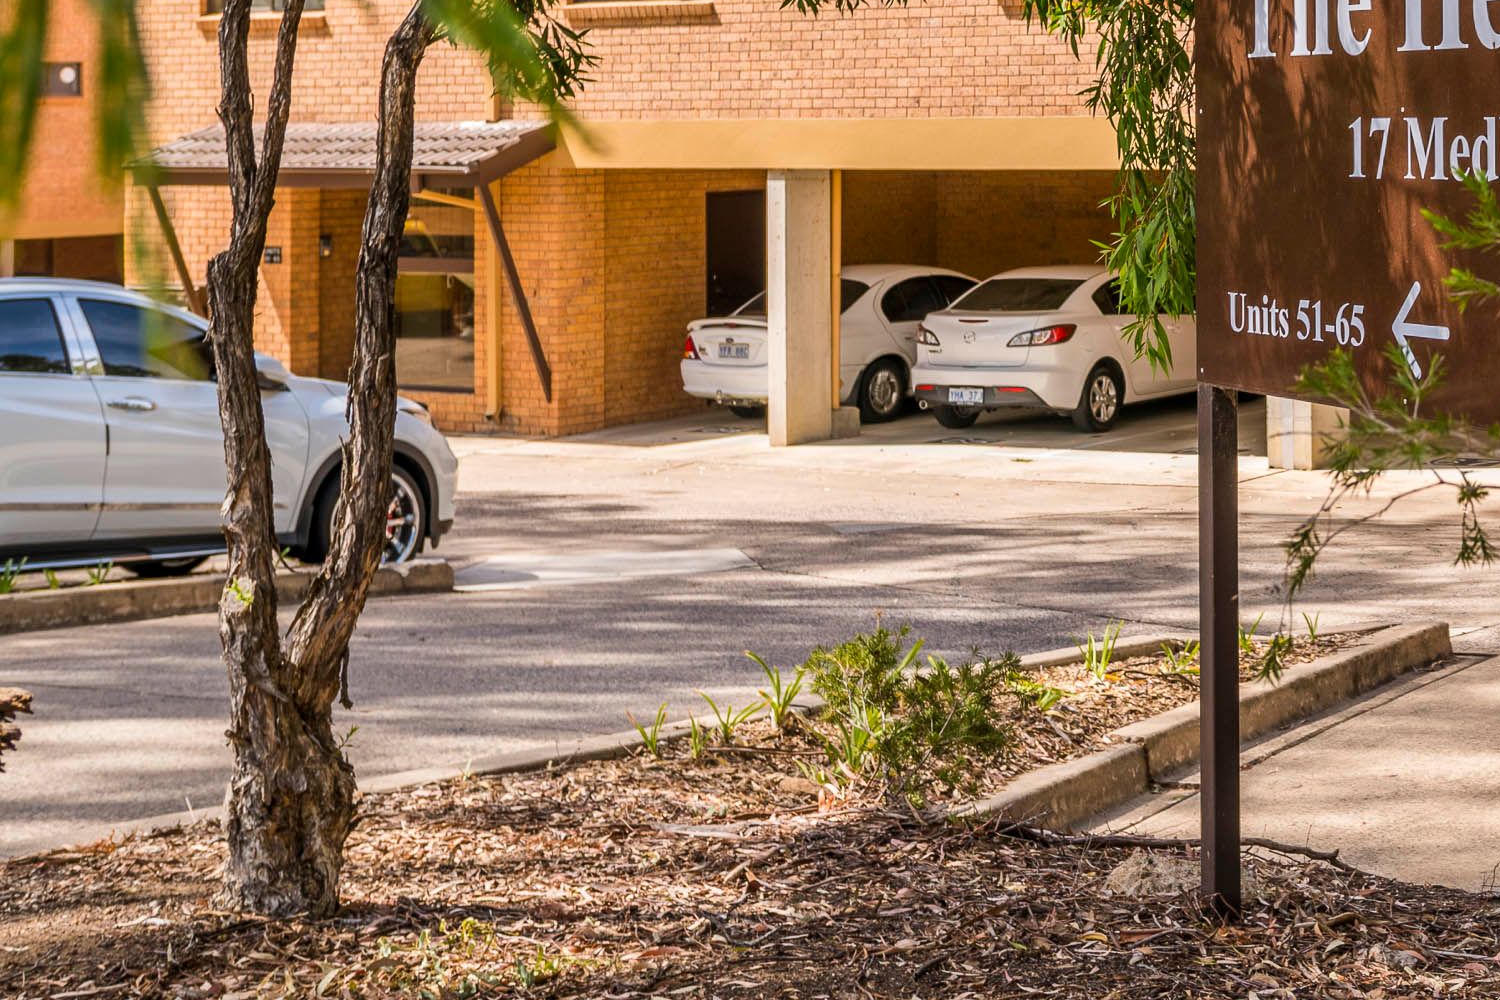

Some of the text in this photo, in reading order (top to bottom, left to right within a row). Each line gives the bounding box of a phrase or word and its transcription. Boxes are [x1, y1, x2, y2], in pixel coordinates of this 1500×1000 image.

[1347, 116, 1391, 180] 17
[1227, 291, 1366, 347] Units 51-65
